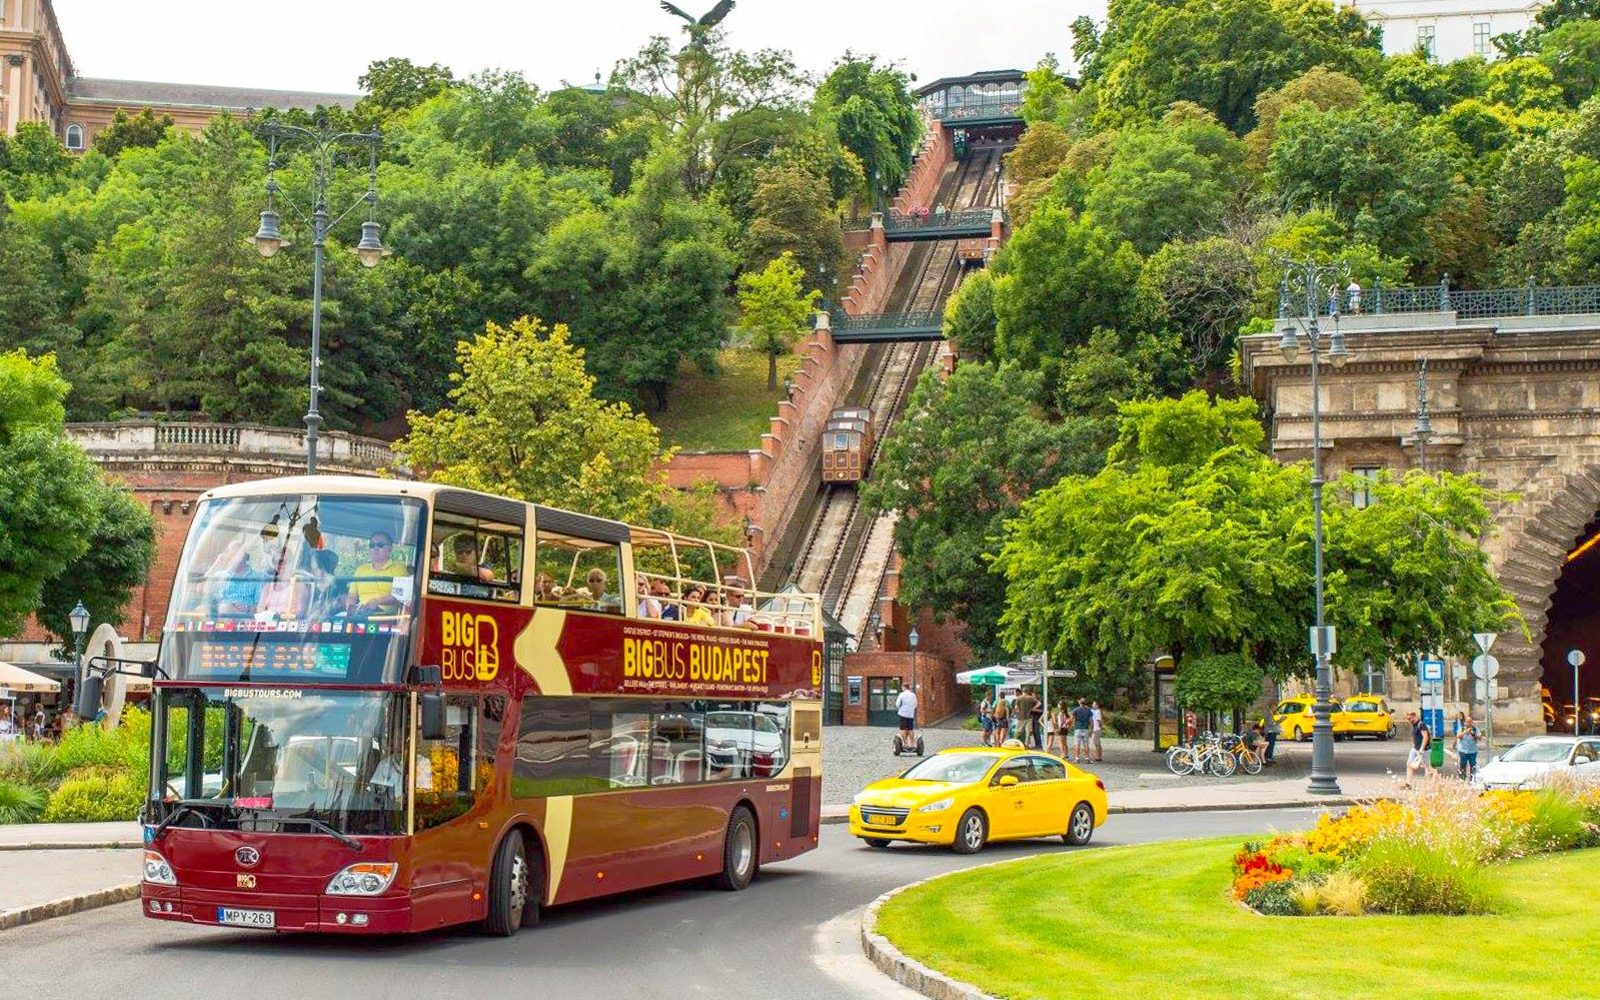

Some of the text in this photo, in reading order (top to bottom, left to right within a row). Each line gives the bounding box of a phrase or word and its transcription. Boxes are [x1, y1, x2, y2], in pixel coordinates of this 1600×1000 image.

[442, 611, 474, 647] BIG
[442, 648, 475, 680] BUS
[690, 644, 769, 683] BUDAPEST
[224, 688, 302, 699] BIGBUSTOURS.COM
[226, 911, 272, 924] MPY-263
